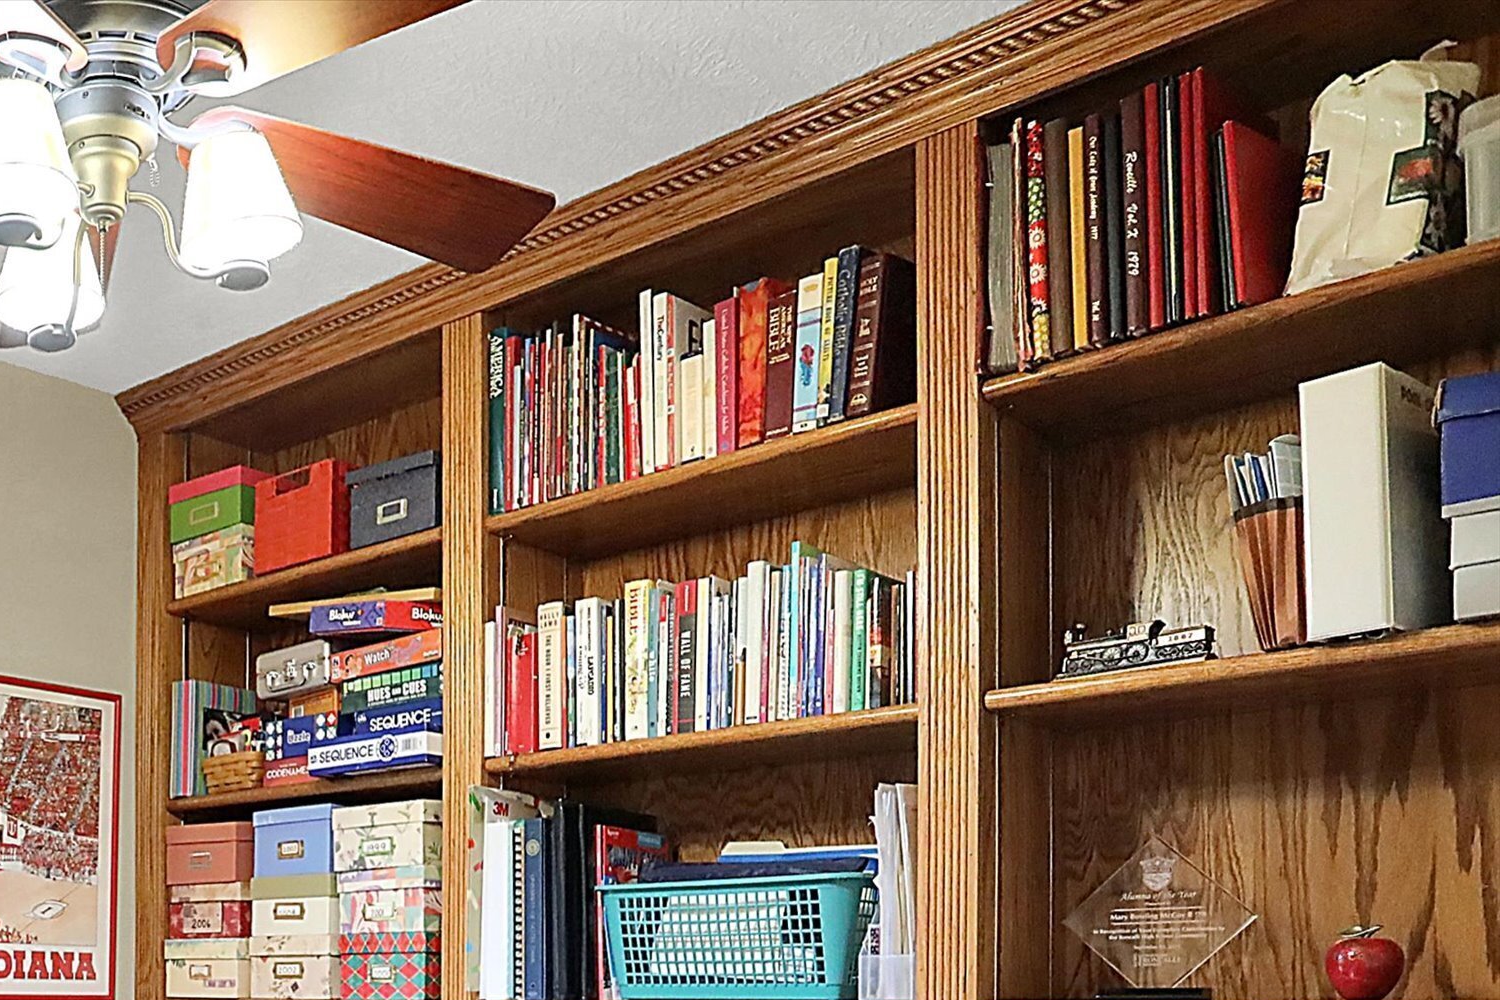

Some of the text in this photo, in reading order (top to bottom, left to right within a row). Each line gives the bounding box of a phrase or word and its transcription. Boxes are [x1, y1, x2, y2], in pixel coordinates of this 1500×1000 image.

[1125, 150, 1138, 194] Reveille
[363, 648, 391, 666] Watch
[680, 630, 692, 698] WALL OF FAME
[366, 686, 391, 703] HUES
[401, 679, 427, 696] CUES
[369, 707, 432, 732] SEQUENCE
[319, 743, 374, 764] SEQUENCE
[266, 766, 309, 779] CODENAME
[492, 800, 509, 817] 3M
[1109, 913, 1128, 921] Mary
